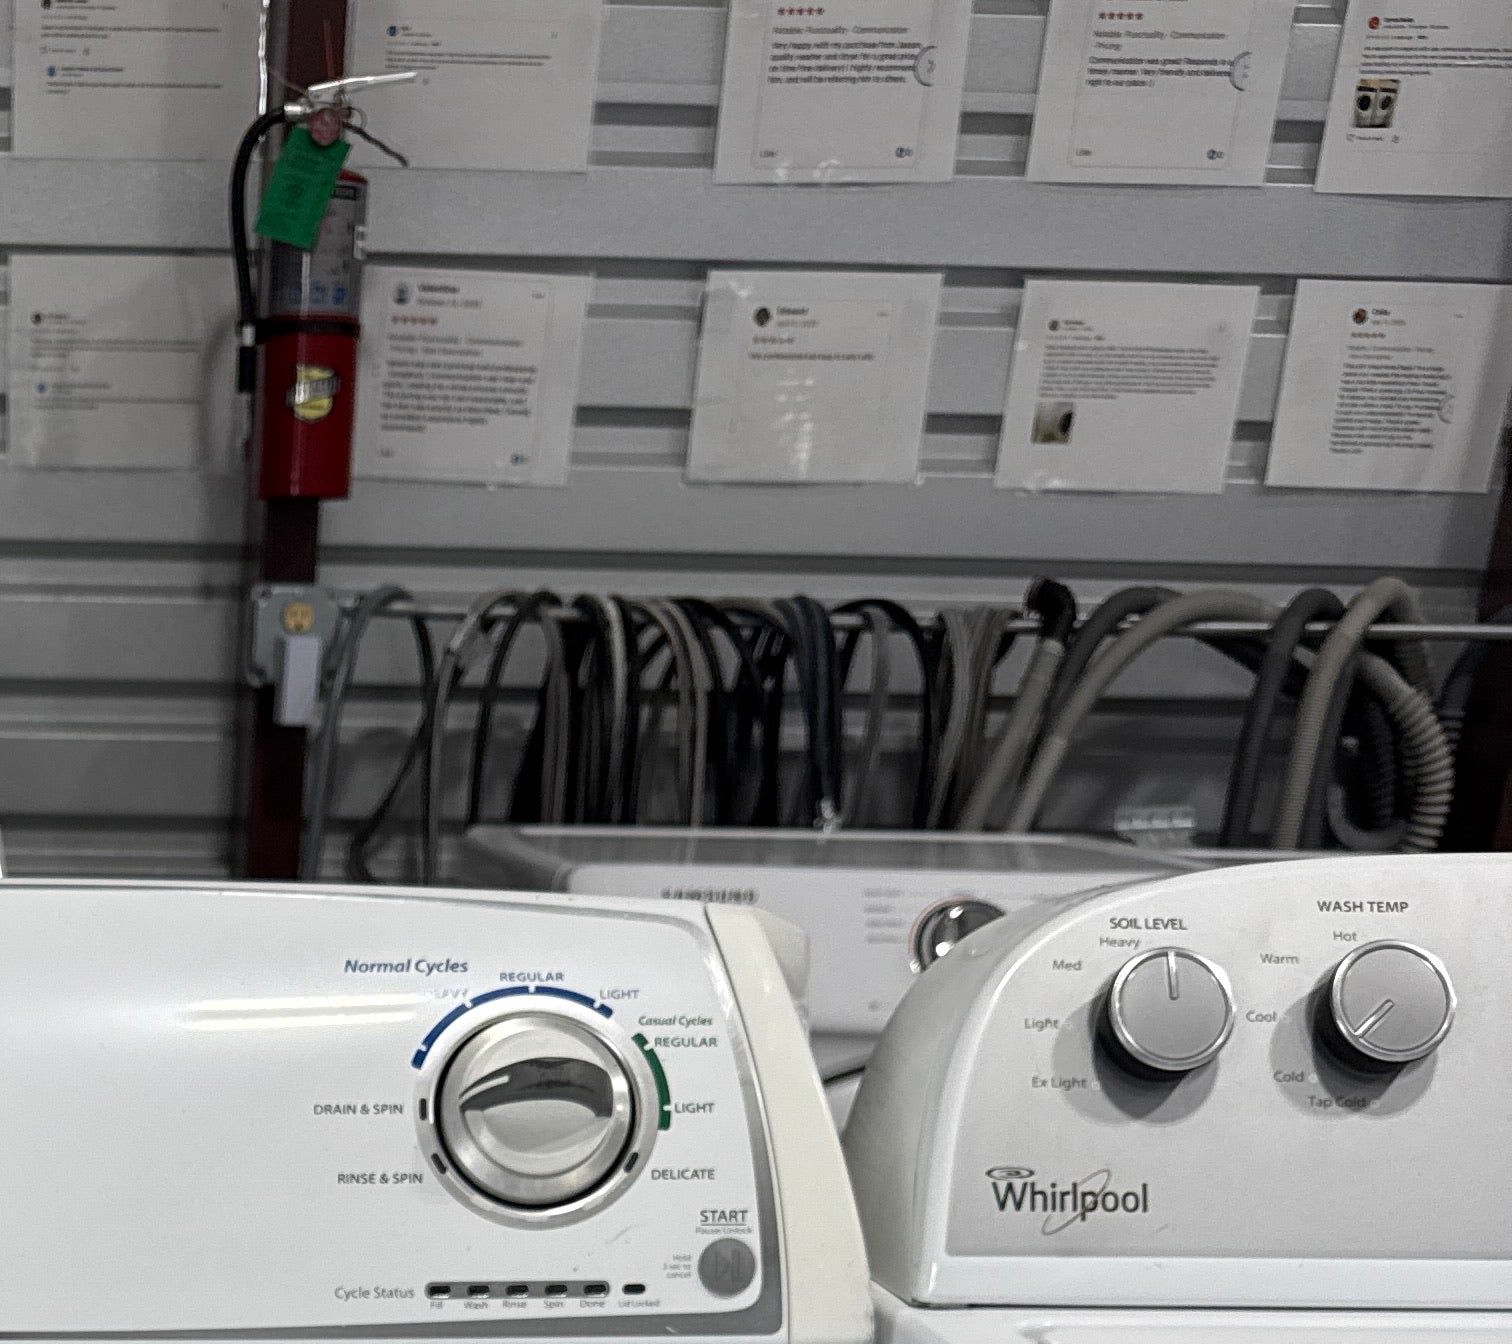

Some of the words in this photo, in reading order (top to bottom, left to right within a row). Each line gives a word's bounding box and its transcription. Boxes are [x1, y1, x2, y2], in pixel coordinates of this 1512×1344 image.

[1317, 901, 1363, 912] WASH
[1367, 901, 1408, 913] TEMP
[1110, 918, 1141, 930] SOIL
[1145, 918, 1187, 930] LEVEL
[1333, 931, 1357, 941] Hot
[1099, 936, 1140, 949] Heavy
[1260, 953, 1299, 964] Warm
[344, 959, 410, 973] Normal
[415, 959, 468, 976] Cycles
[1052, 960, 1082, 971] Med
[499, 972, 565, 982] REGULAR
[599, 989, 639, 1000] LIGHT
[638, 1015, 676, 1026] Casual
[678, 1016, 713, 1028] Cycles
[1246, 1010, 1276, 1022] Cool
[1024, 1018, 1059, 1032] Light
[654, 1037, 718, 1048] REGULAR
[1273, 1071, 1304, 1083] Cold
[1032, 1077, 1048, 1087] Ex
[1051, 1077, 1086, 1091] Light
[1308, 1096, 1332, 1108] Tap
[1335, 1096, 1367, 1108] Cold
[313, 1104, 357, 1115] DRAIN
[360, 1104, 370, 1115] &
[373, 1104, 404, 1115] SPIN
[674, 1103, 715, 1114] LIGHT
[337, 1173, 375, 1184] RINSE
[379, 1173, 389, 1184] &
[392, 1173, 423, 1184] SPIN
[651, 1169, 715, 1180] DELICATE
[991, 1181, 1149, 1222] Whirlpool
[700, 1209, 749, 1222] START
[334, 1287, 370, 1300] Cycle
[373, 1287, 415, 1299] Status
[464, 1301, 488, 1309] Wash
